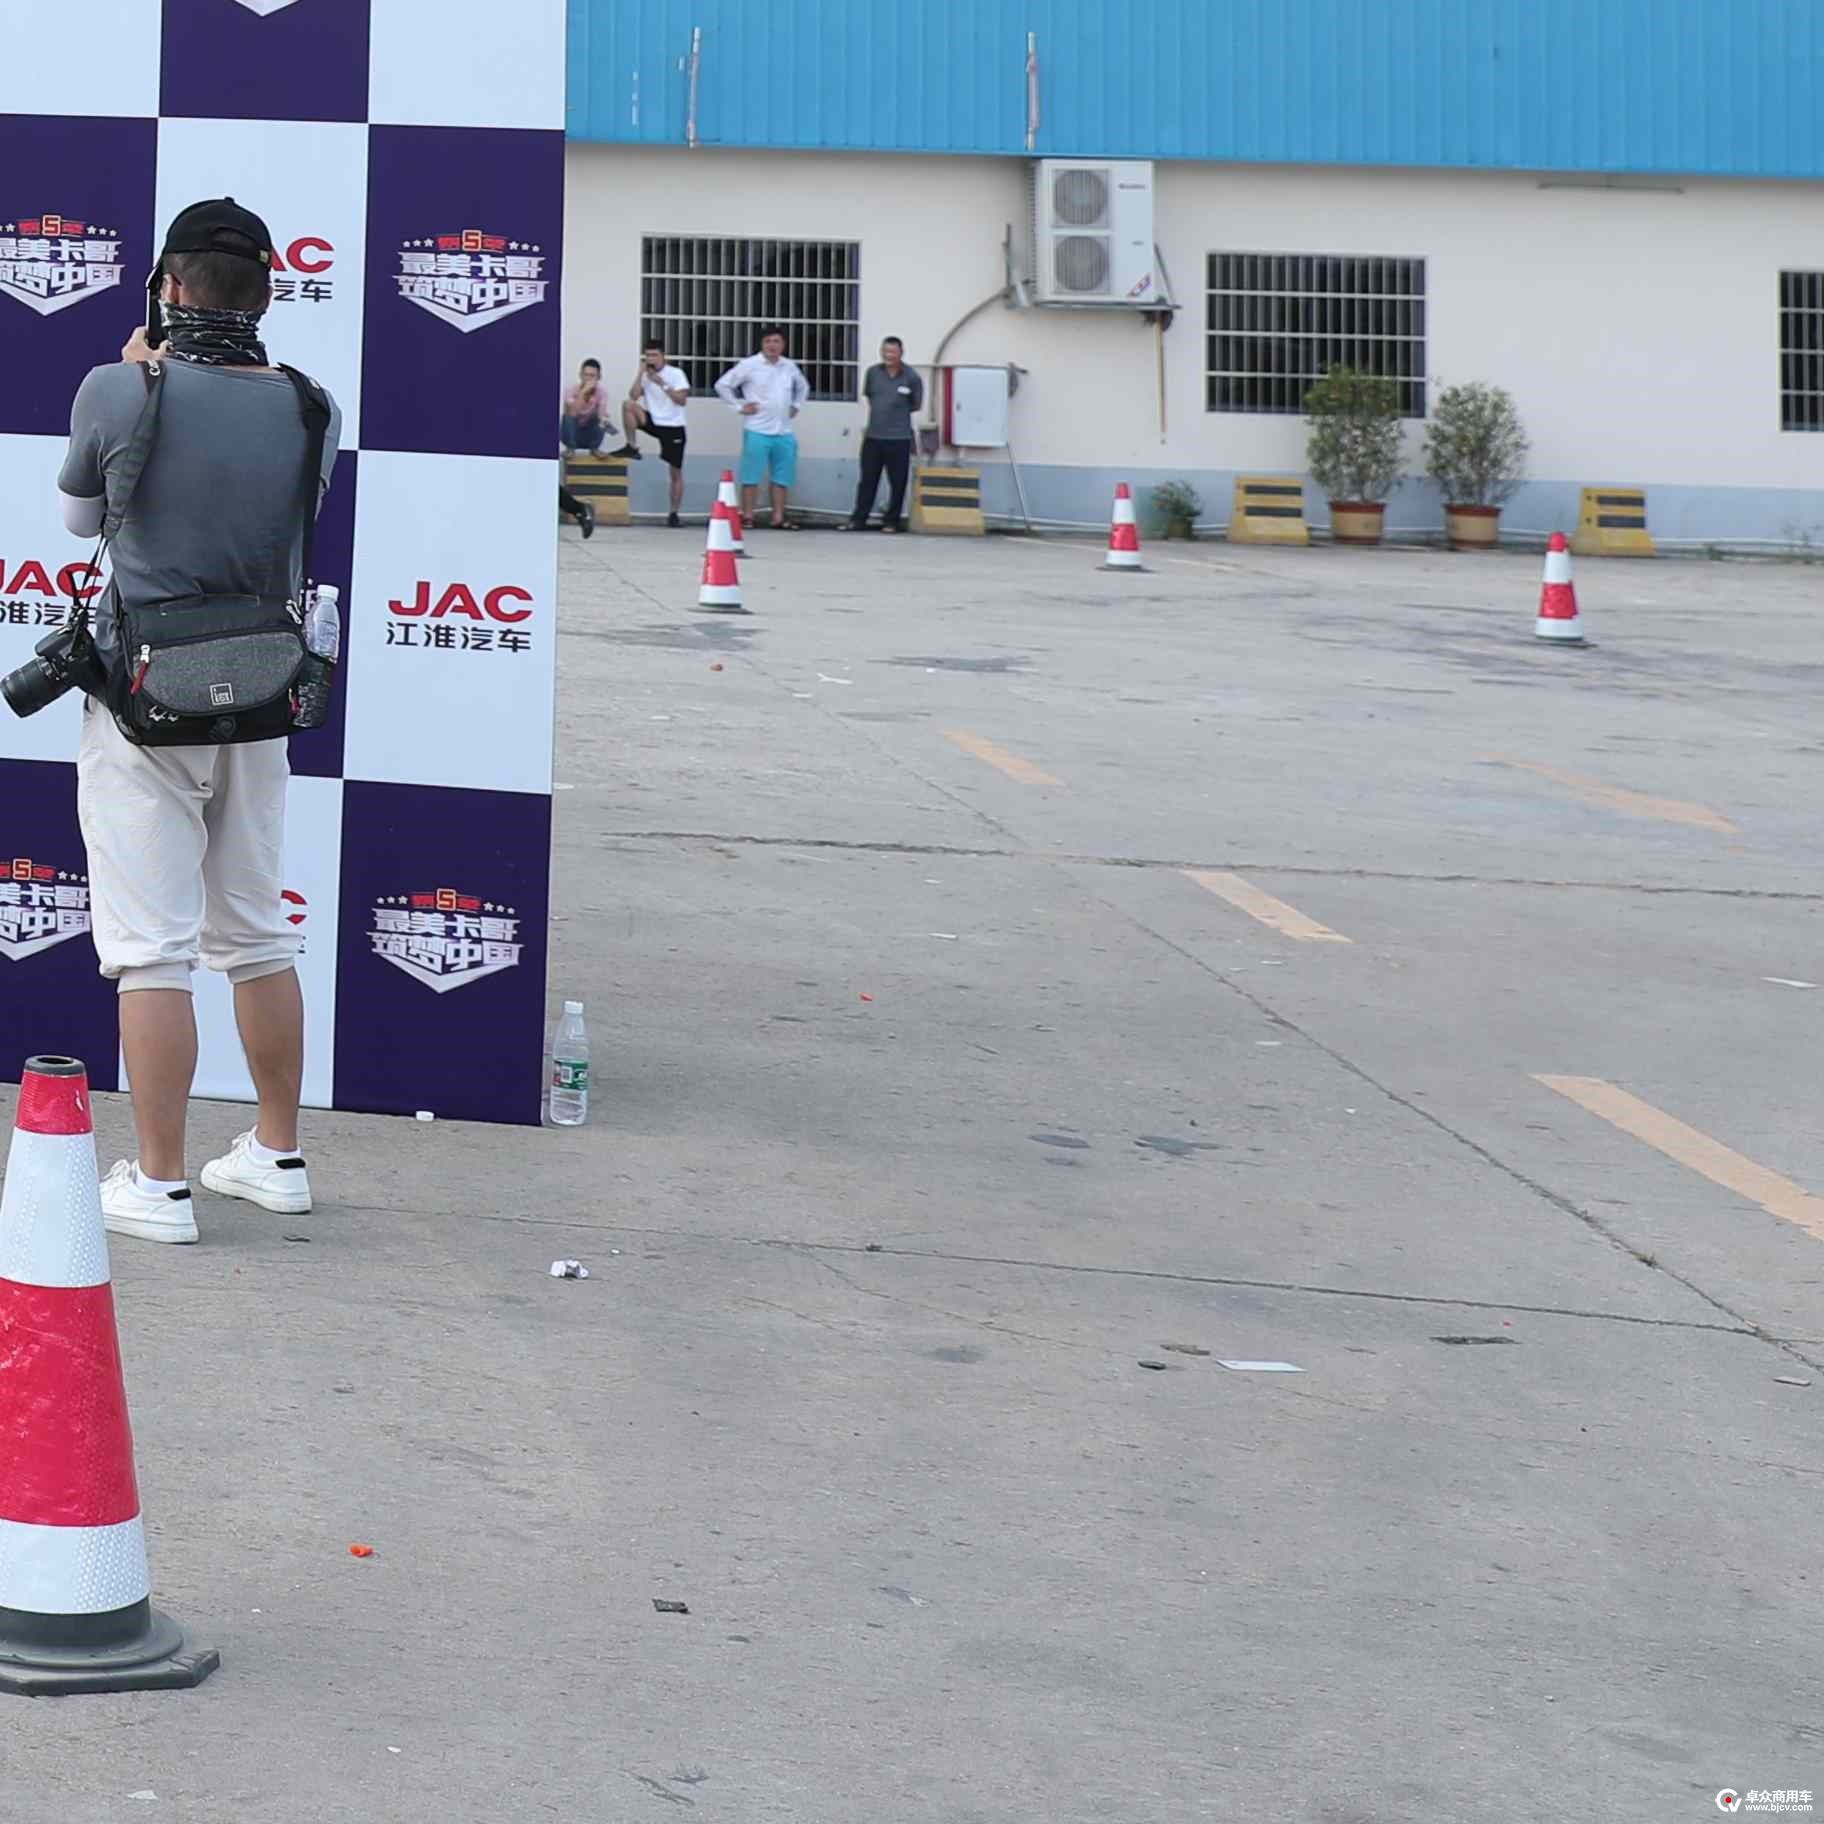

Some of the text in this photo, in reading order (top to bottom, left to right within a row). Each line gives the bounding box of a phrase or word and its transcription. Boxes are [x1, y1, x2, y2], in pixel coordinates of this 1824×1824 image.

[397, 252, 545, 279] 最美卡哥
[391, 276, 550, 315] 筑梦中国
[388, 582, 531, 623] JAC
[386, 621, 532, 653] 江淮汽车
[371, 907, 521, 937] 最美卡哥
[365, 931, 524, 974] 筑梦中国
